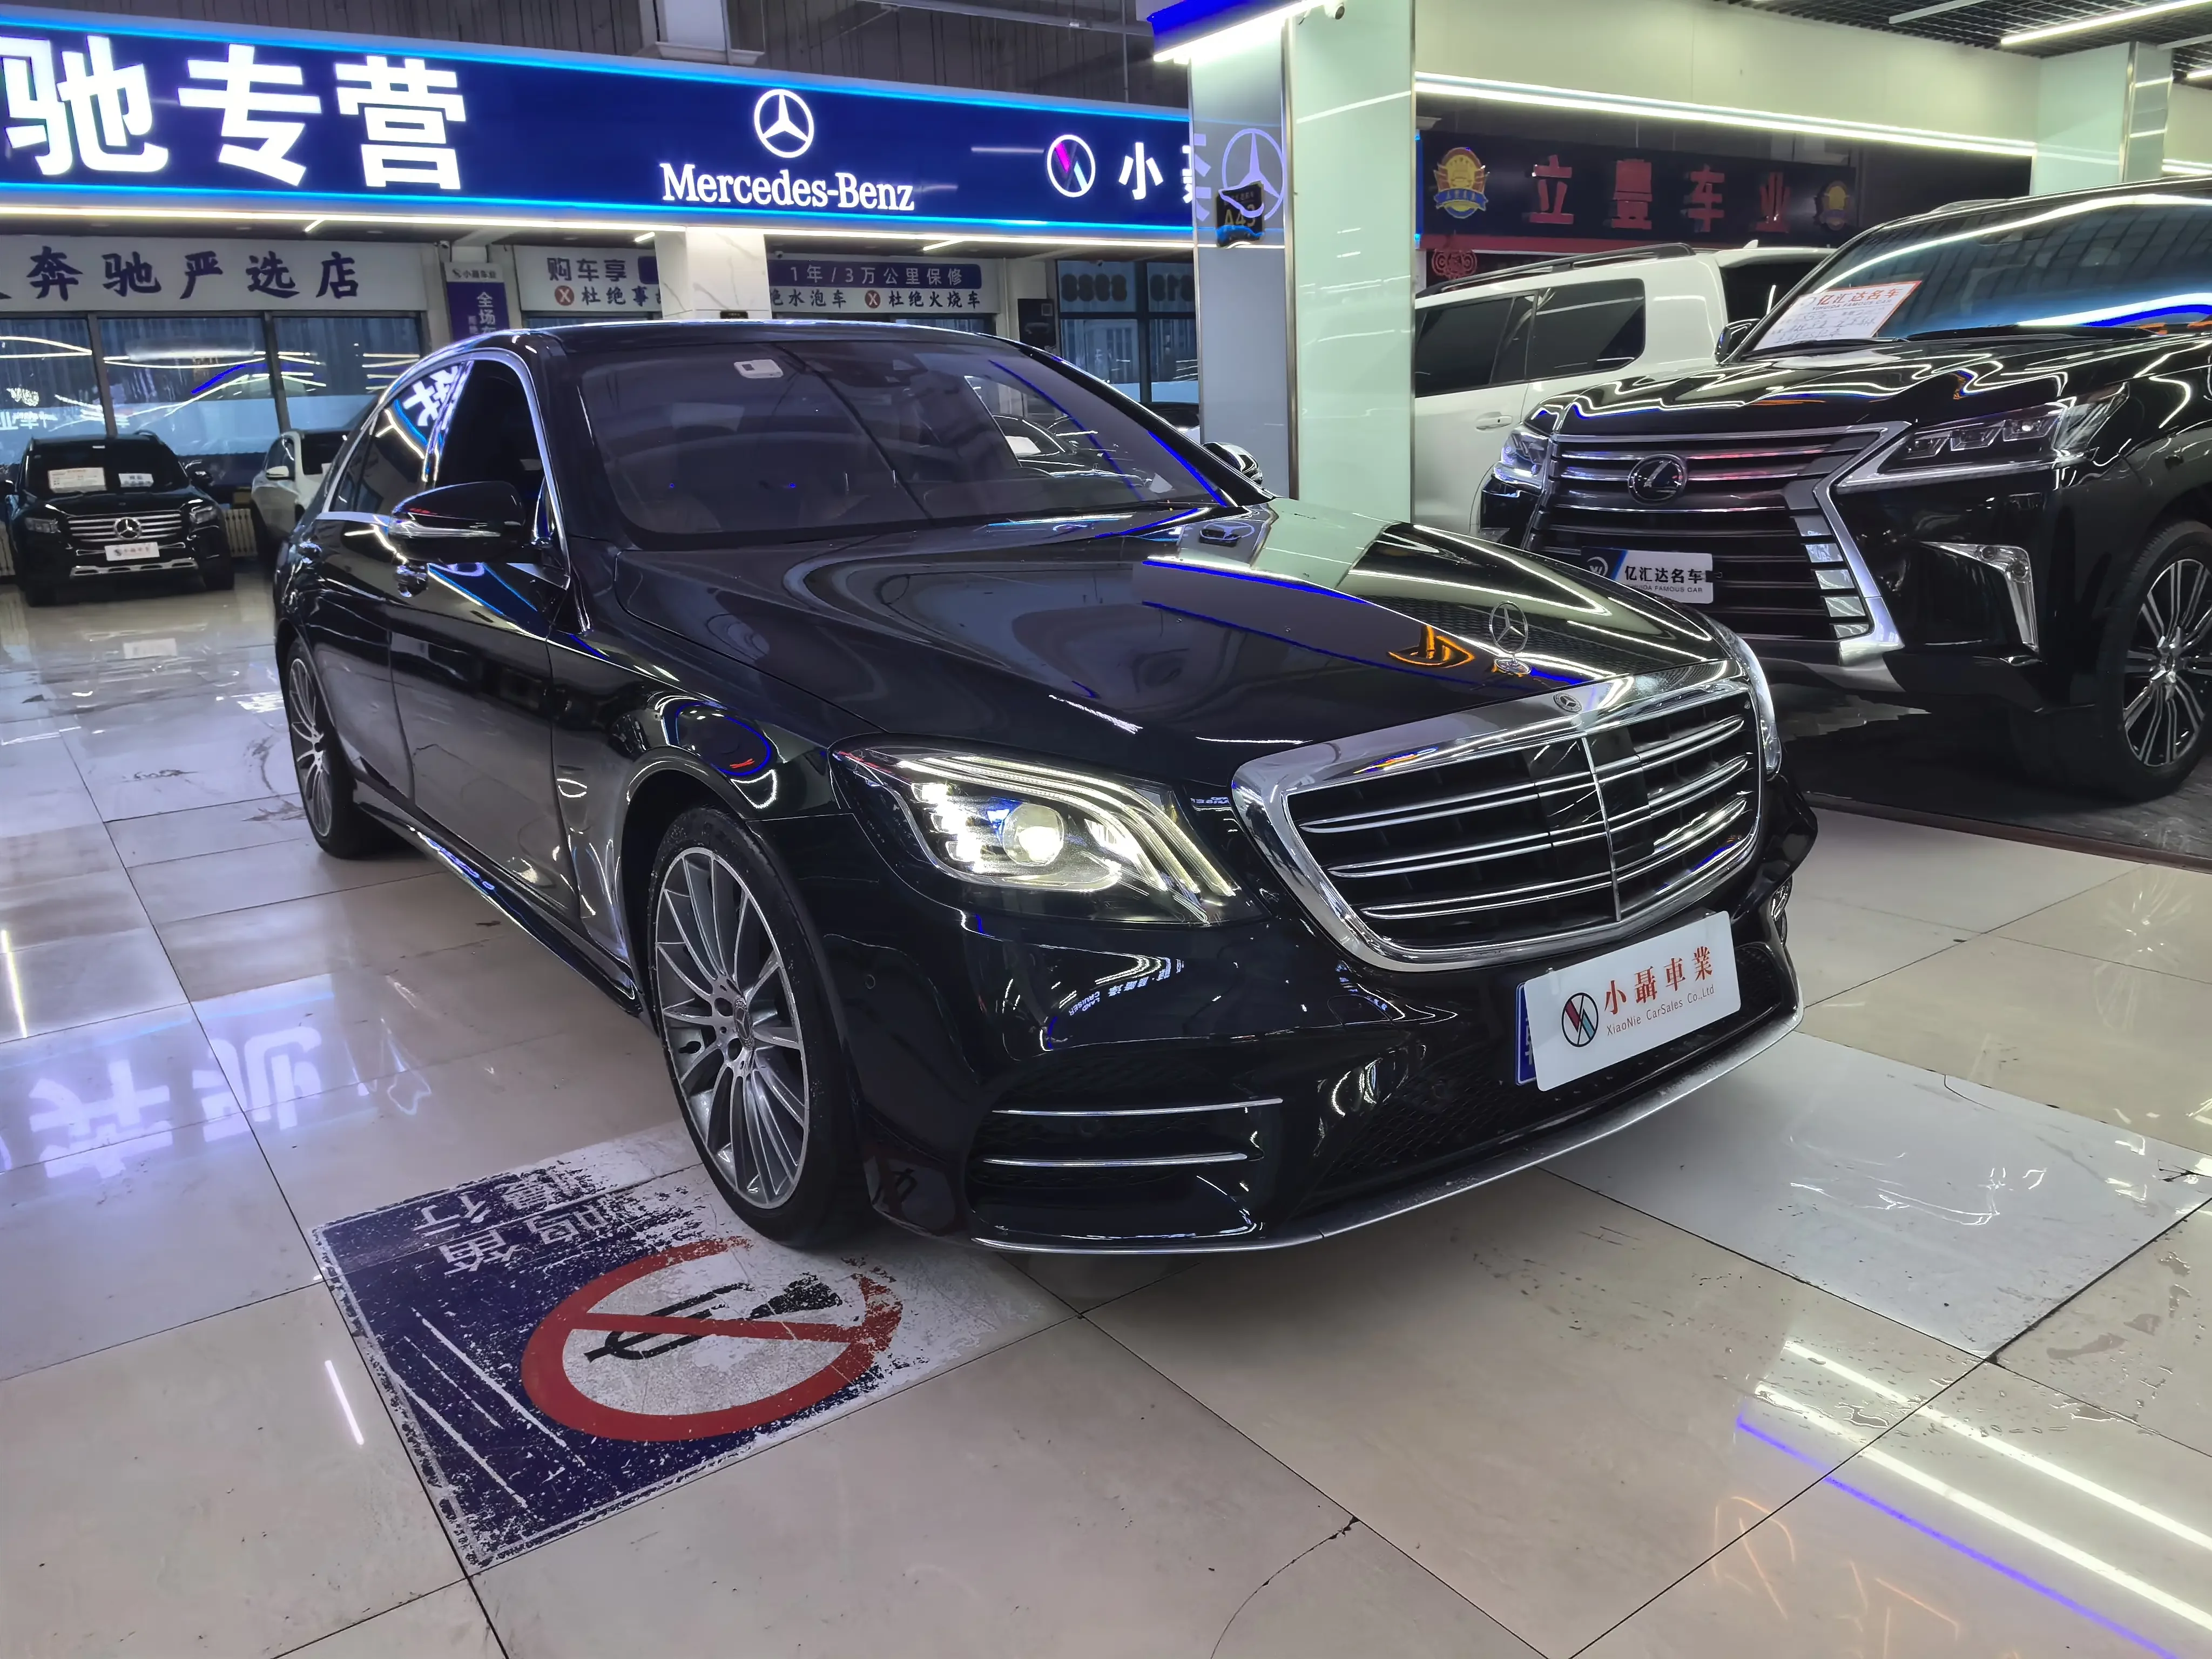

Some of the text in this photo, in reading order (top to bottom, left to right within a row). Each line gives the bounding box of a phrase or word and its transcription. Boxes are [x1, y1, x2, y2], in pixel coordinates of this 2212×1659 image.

[0, 35, 466, 190] 驰专营
[660, 163, 915, 211] Mercedes-Benz
[0, 246, 360, 301] 奔驰严选店
[547, 257, 627, 282] 购车享
[790, 264, 962, 286] 1年/3万公里保修
[581, 286, 661, 306] 杜绝事
[889, 290, 980, 308] 杜绝火烧车
[1817, 288, 1903, 305] 亿汇达名车
[1624, 565, 1702, 584] 亿汇达名车
[1607, 984, 1715, 1036] XiaoNie CarSales Co.,Ltd
